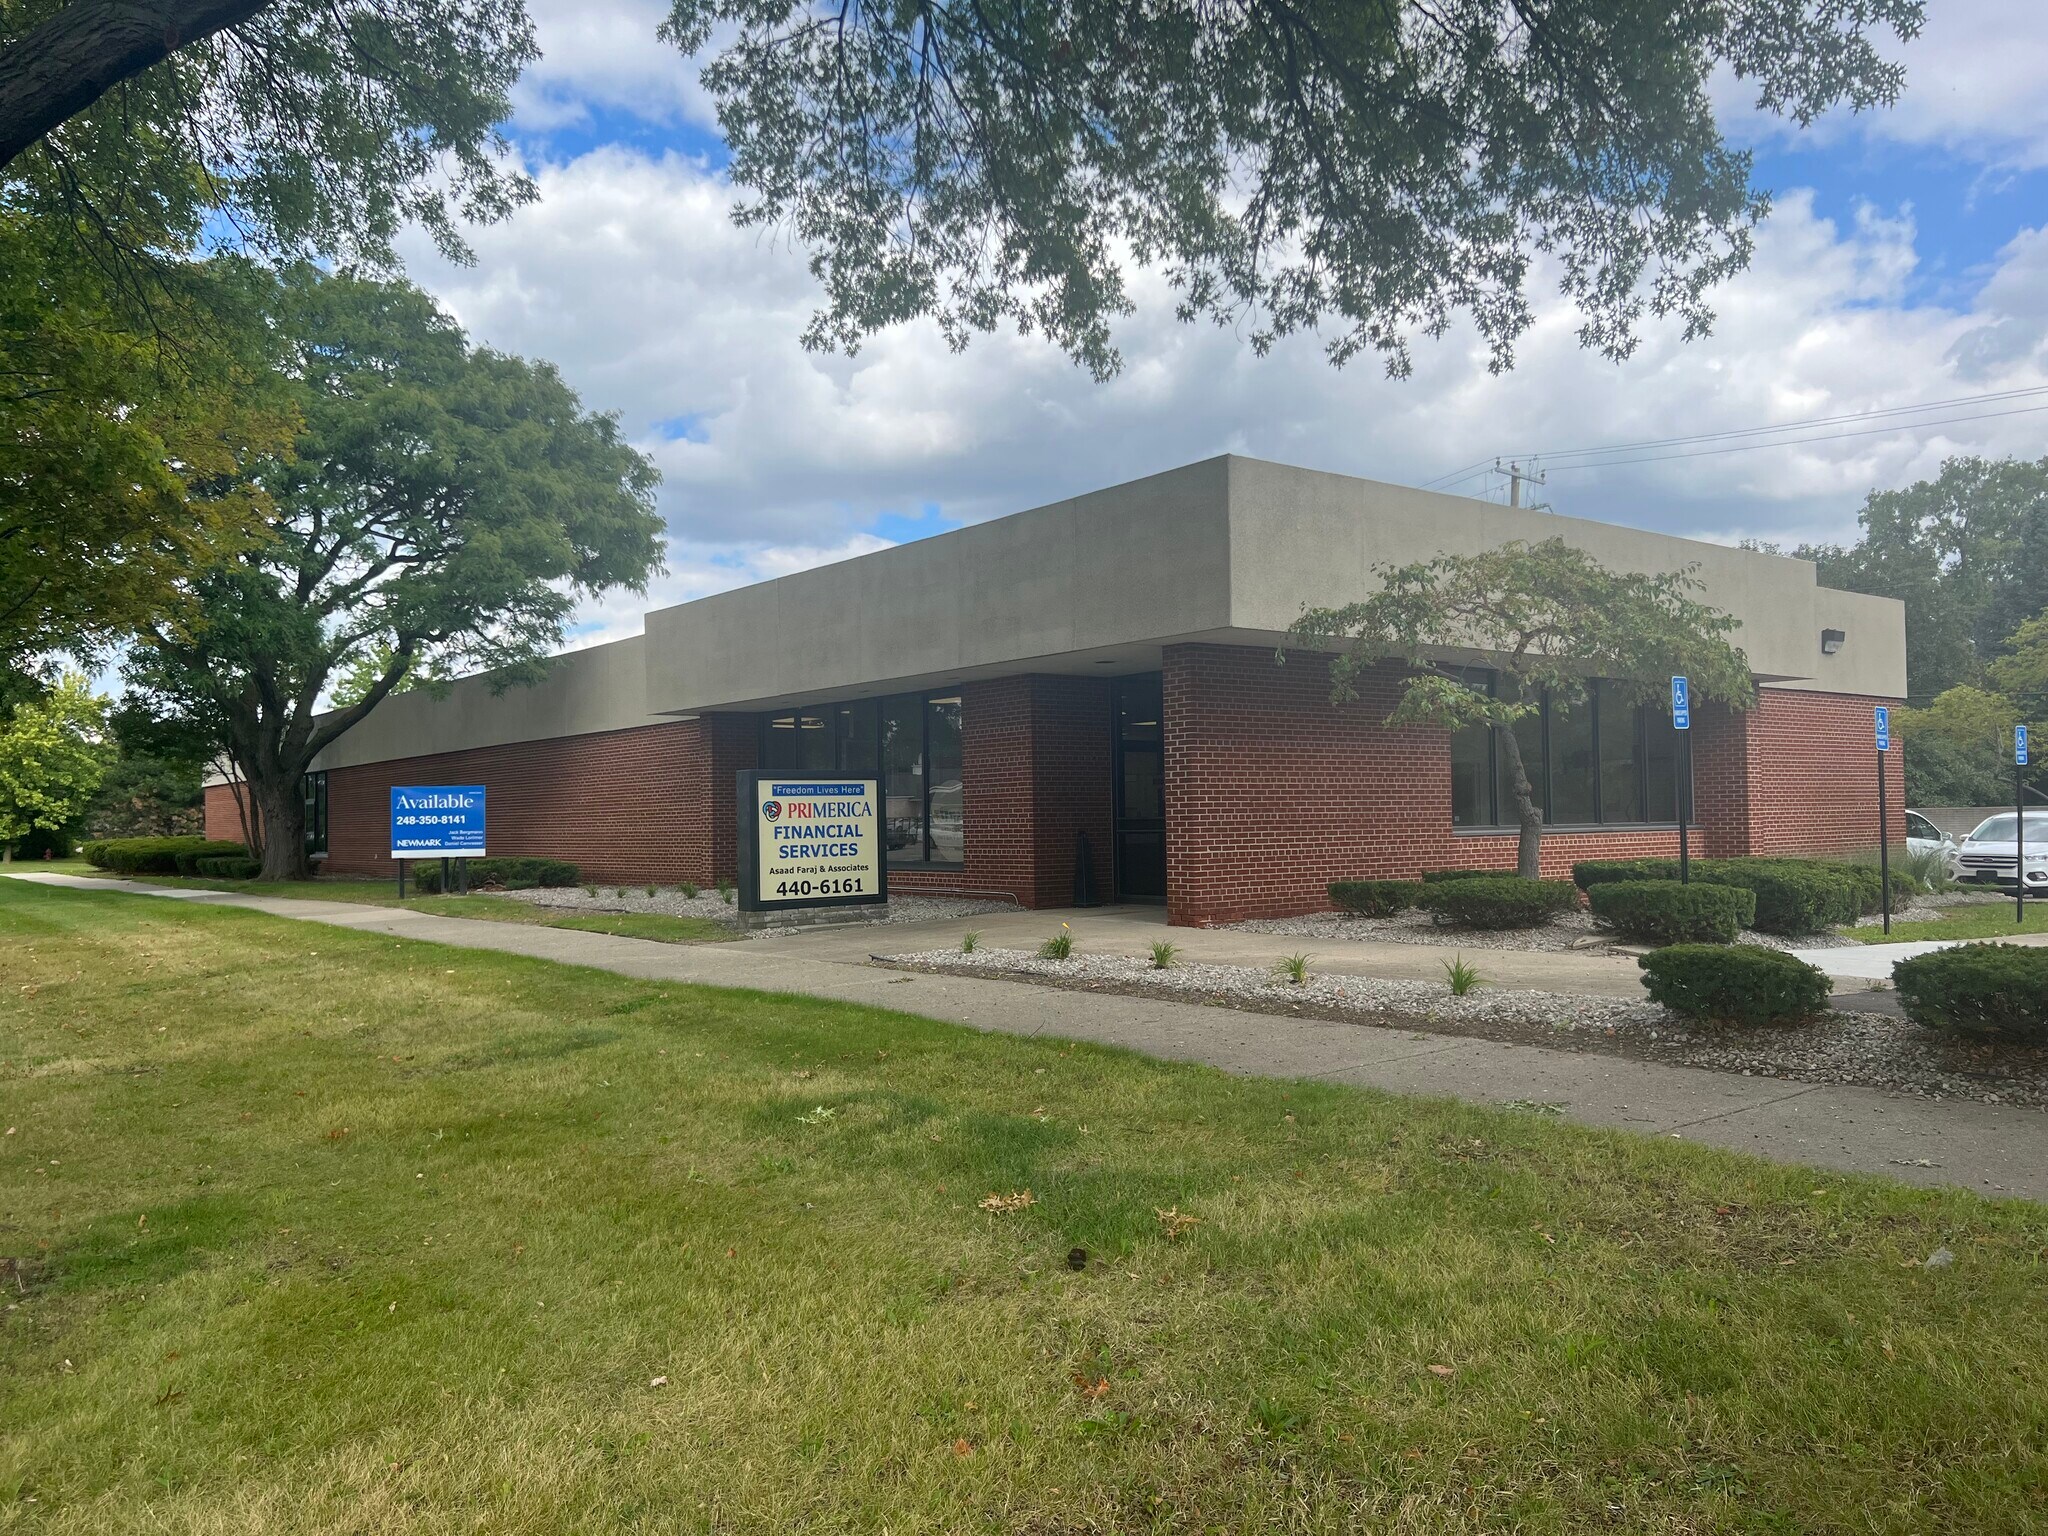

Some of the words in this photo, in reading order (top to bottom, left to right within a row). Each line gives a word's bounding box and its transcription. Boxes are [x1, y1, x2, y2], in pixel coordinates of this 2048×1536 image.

[773, 785, 814, 795] "Freedom
[816, 785, 839, 794] Lives
[841, 785, 864, 794] Here"
[396, 794, 474, 810] Available
[788, 801, 872, 818] PRIMERICA
[396, 815, 466, 825] 248-350-8141
[774, 824, 863, 840] FINANCIAL
[397, 838, 442, 847] NEWMARK
[779, 843, 858, 859] SERVICES
[769, 867, 795, 875] Asaad
[797, 865, 817, 875] Faraj
[828, 864, 869, 873] Associates
[776, 878, 863, 897] 440-6161
